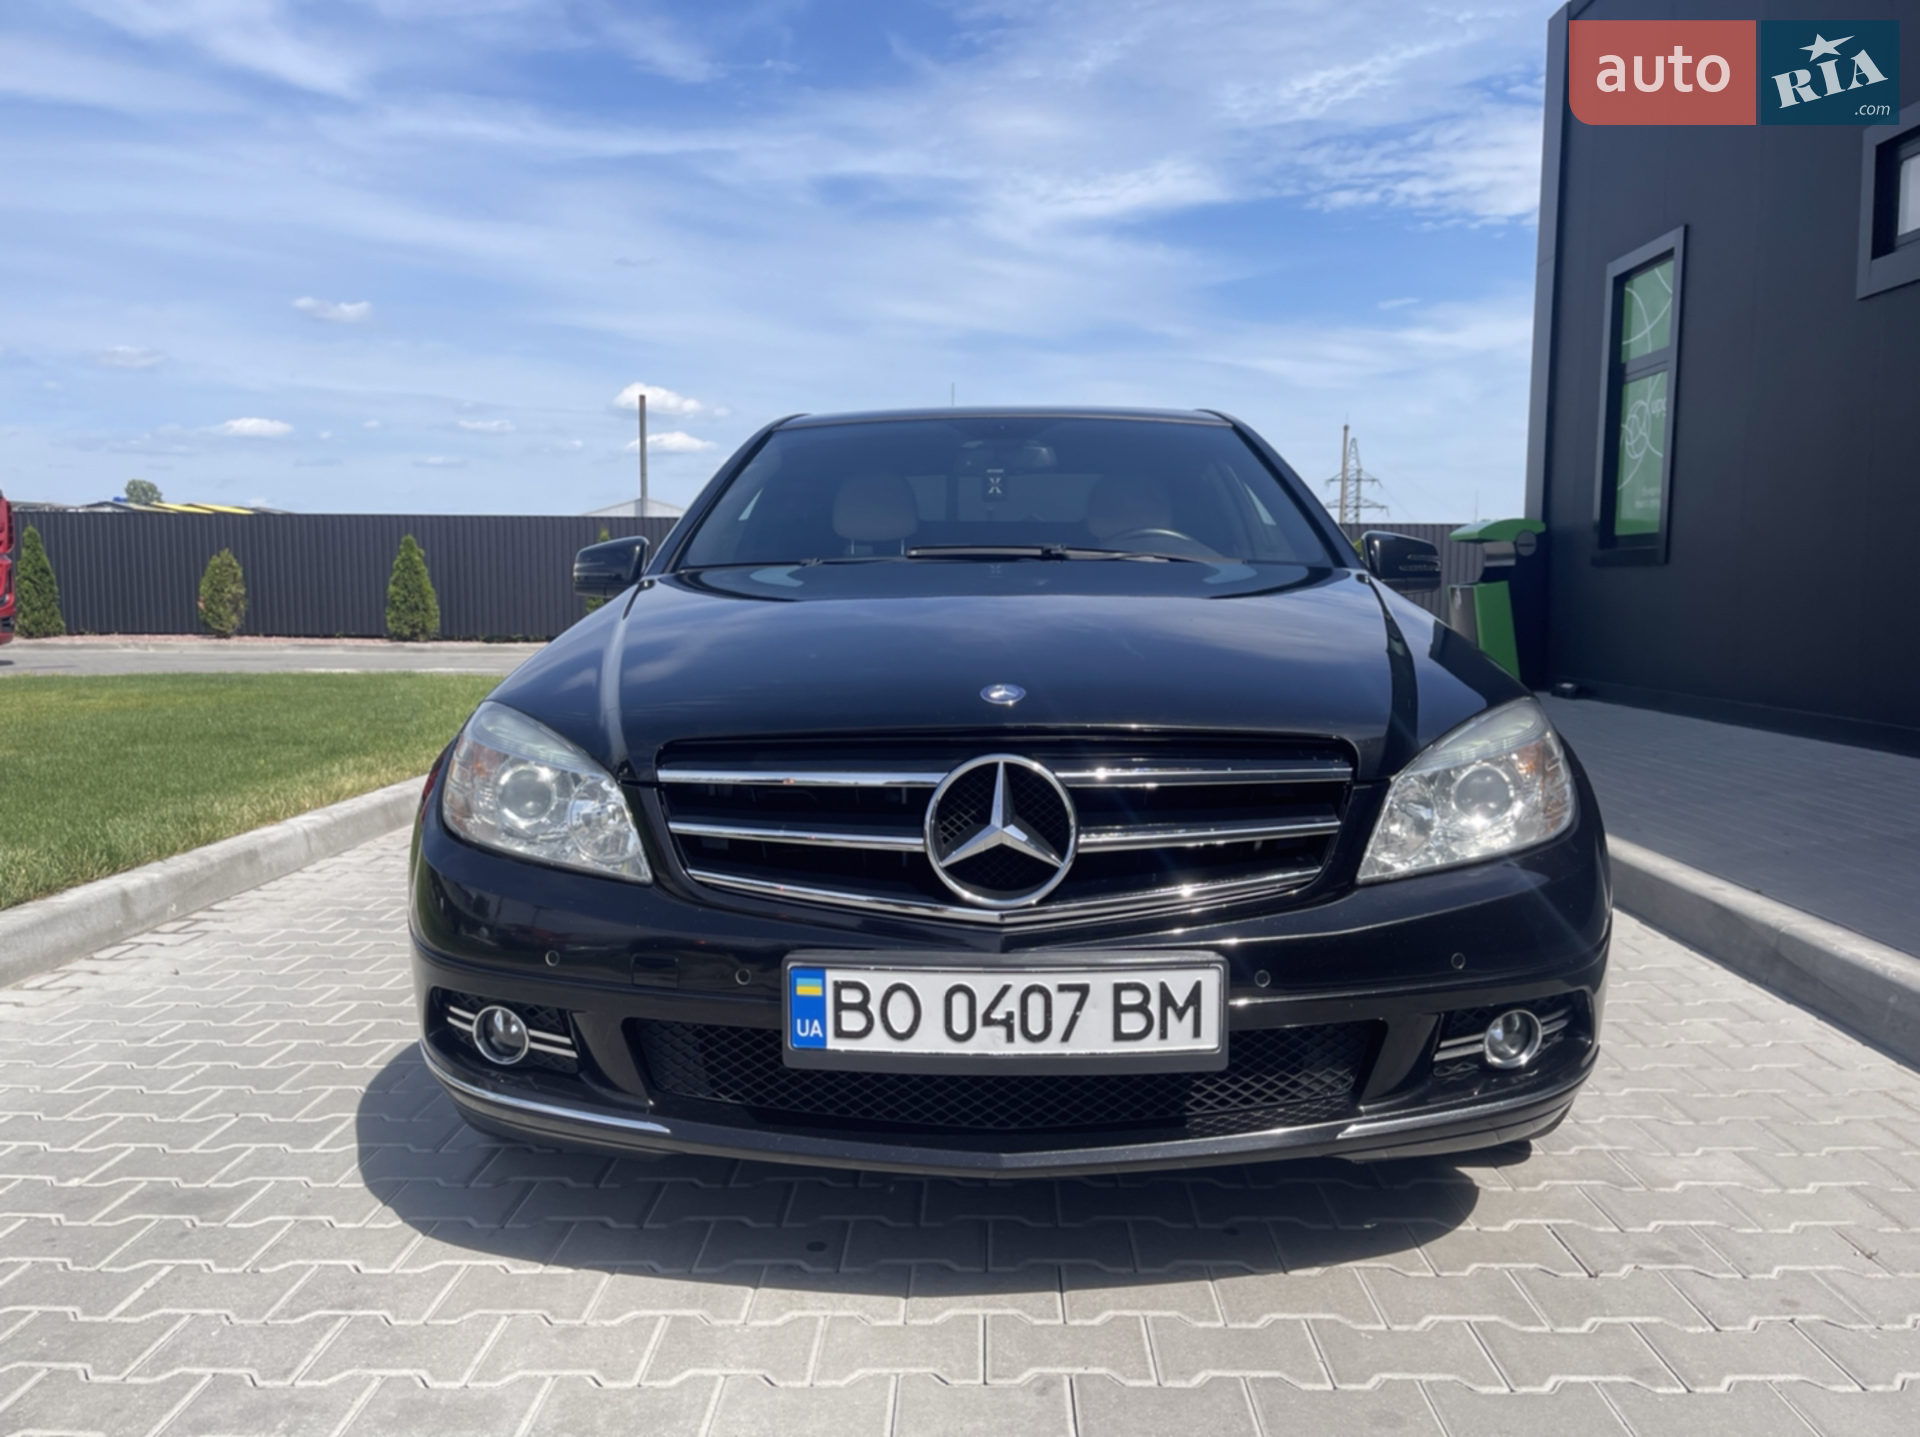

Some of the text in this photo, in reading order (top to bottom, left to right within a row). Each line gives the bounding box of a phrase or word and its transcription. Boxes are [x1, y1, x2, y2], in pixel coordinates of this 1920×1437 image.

[796, 1018, 824, 1038] UA
[833, 979, 1202, 1043] BO 0407 BM
